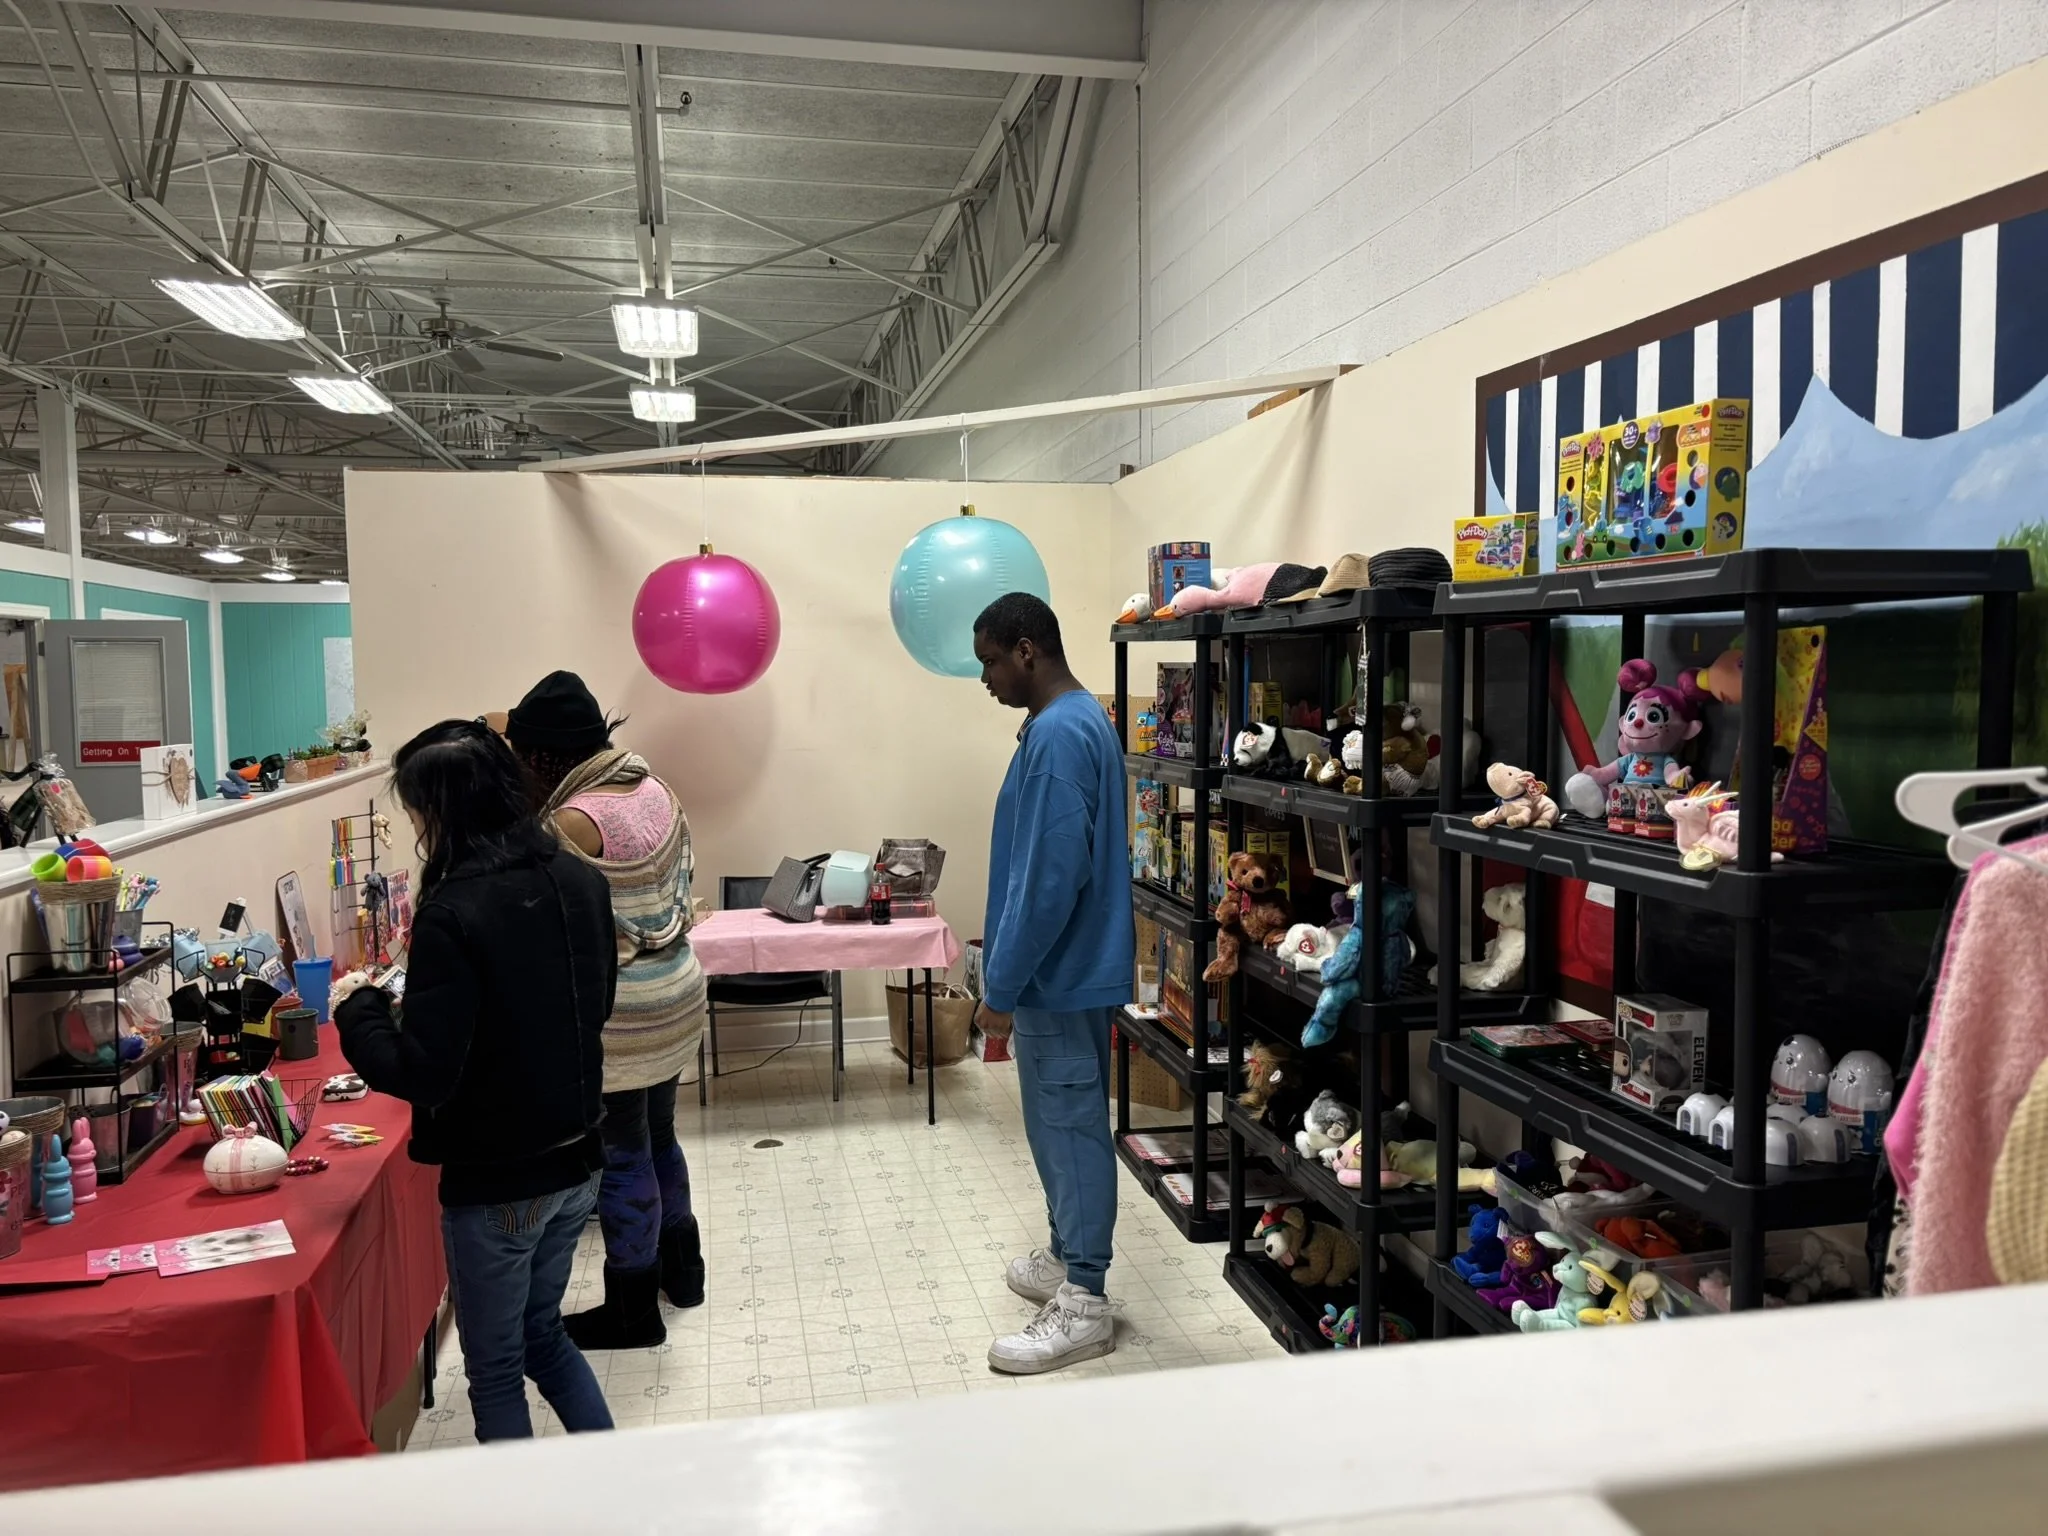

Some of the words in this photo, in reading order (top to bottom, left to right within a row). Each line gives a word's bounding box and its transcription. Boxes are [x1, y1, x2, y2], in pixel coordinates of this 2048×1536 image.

[1624, 425, 1638, 437] 30+
[82, 747, 112, 757] Getting
[118, 747, 129, 756] On
[1692, 1036, 1705, 1083] ELEVEN
